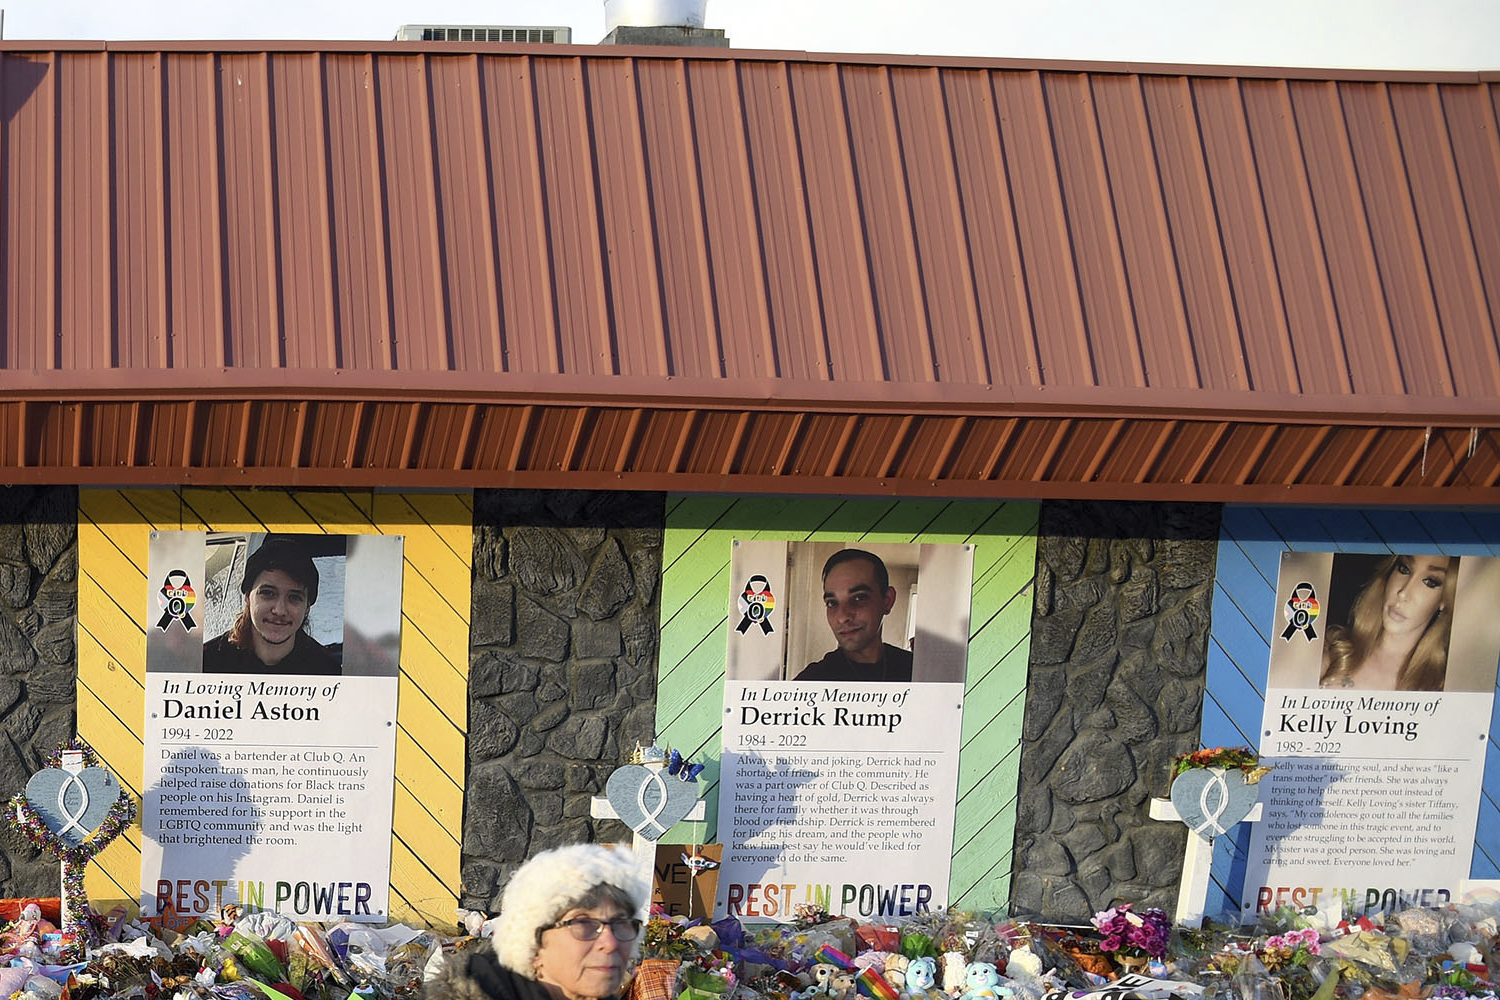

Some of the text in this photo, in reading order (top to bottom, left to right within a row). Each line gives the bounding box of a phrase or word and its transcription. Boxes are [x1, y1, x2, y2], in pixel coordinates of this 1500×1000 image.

[168, 597, 186, 618] Q
[162, 680, 340, 702] In Loving Memory of
[740, 687, 910, 708] In Loving Memory of
[163, 699, 320, 721] Daniel Aston
[1280, 696, 1442, 716] In Loving Memory of
[740, 706, 902, 733] Derrick Rump
[1279, 714, 1419, 740] Kelly Loving
[161, 728, 190, 740] 1994
[204, 729, 233, 741] 2022
[738, 734, 766, 747] 1984
[778, 735, 807, 747] 2022
[1276, 741, 1303, 753] 1982
[1315, 742, 1341, 754] 2022
[162, 750, 197, 760] Daniel
[234, 751, 286, 761] bartender
[290, 753, 300, 762] at
[304, 752, 330, 762] Club
[333, 752, 345, 764] Q.
[349, 752, 365, 763] An
[737, 756, 773, 769] Always
[776, 756, 808, 769] bubbly
[811, 756, 829, 766] and
[867, 757, 901, 766] Derrick
[904, 757, 921, 766] had
[161, 764, 368, 781] outspoken trans man, he continuously
[161, 778, 365, 792] helped raise donations for Black trans
[160, 792, 197, 806] people
[217, 793, 233, 803] his
[236, 793, 293, 808] Instagram.
[298, 794, 333, 804] Daniel
[336, 794, 344, 804] is
[160, 806, 346, 822] remembered for his support in the
[160, 820, 200, 832] LGBTQ
[204, 820, 265, 835] community
[269, 821, 290, 831] and
[318, 822, 334, 832] the
[338, 822, 362, 836] light
[159, 834, 180, 844] that
[184, 834, 242, 849] brightened
[246, 835, 262, 845] the
[156, 880, 372, 916] REST IN POWER
[727, 884, 932, 917] REST IN POWER
